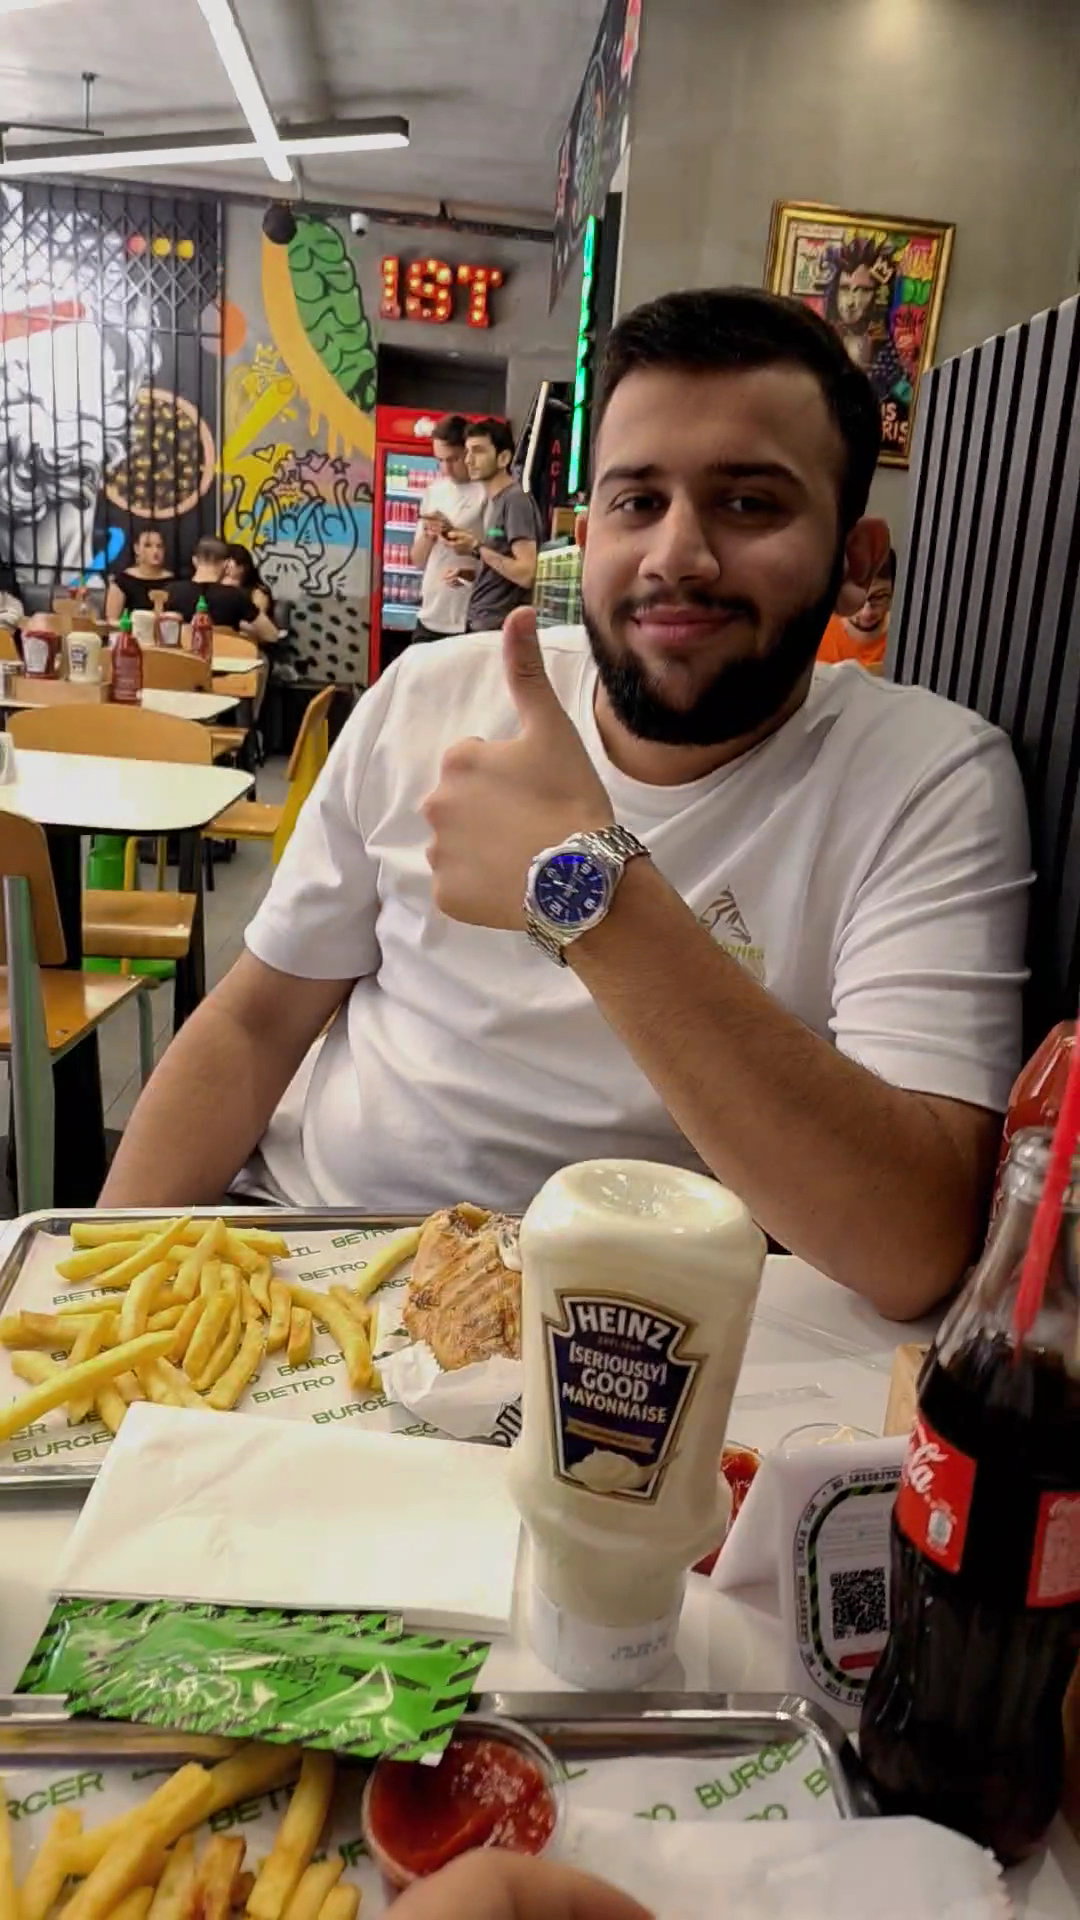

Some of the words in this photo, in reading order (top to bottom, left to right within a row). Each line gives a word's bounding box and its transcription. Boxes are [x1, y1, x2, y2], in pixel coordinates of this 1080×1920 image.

[380, 256, 503, 328] IST
[298, 1260, 368, 1282] BETRO
[575, 1304, 672, 1351] HEINZ
[251, 1375, 336, 1404] BETRO
[580, 1368, 650, 1403] GOOD
[311, 1394, 398, 1425] BURGE
[561, 1382, 669, 1425] MAYONNAISE
[12, 1430, 117, 1463] BURGE
